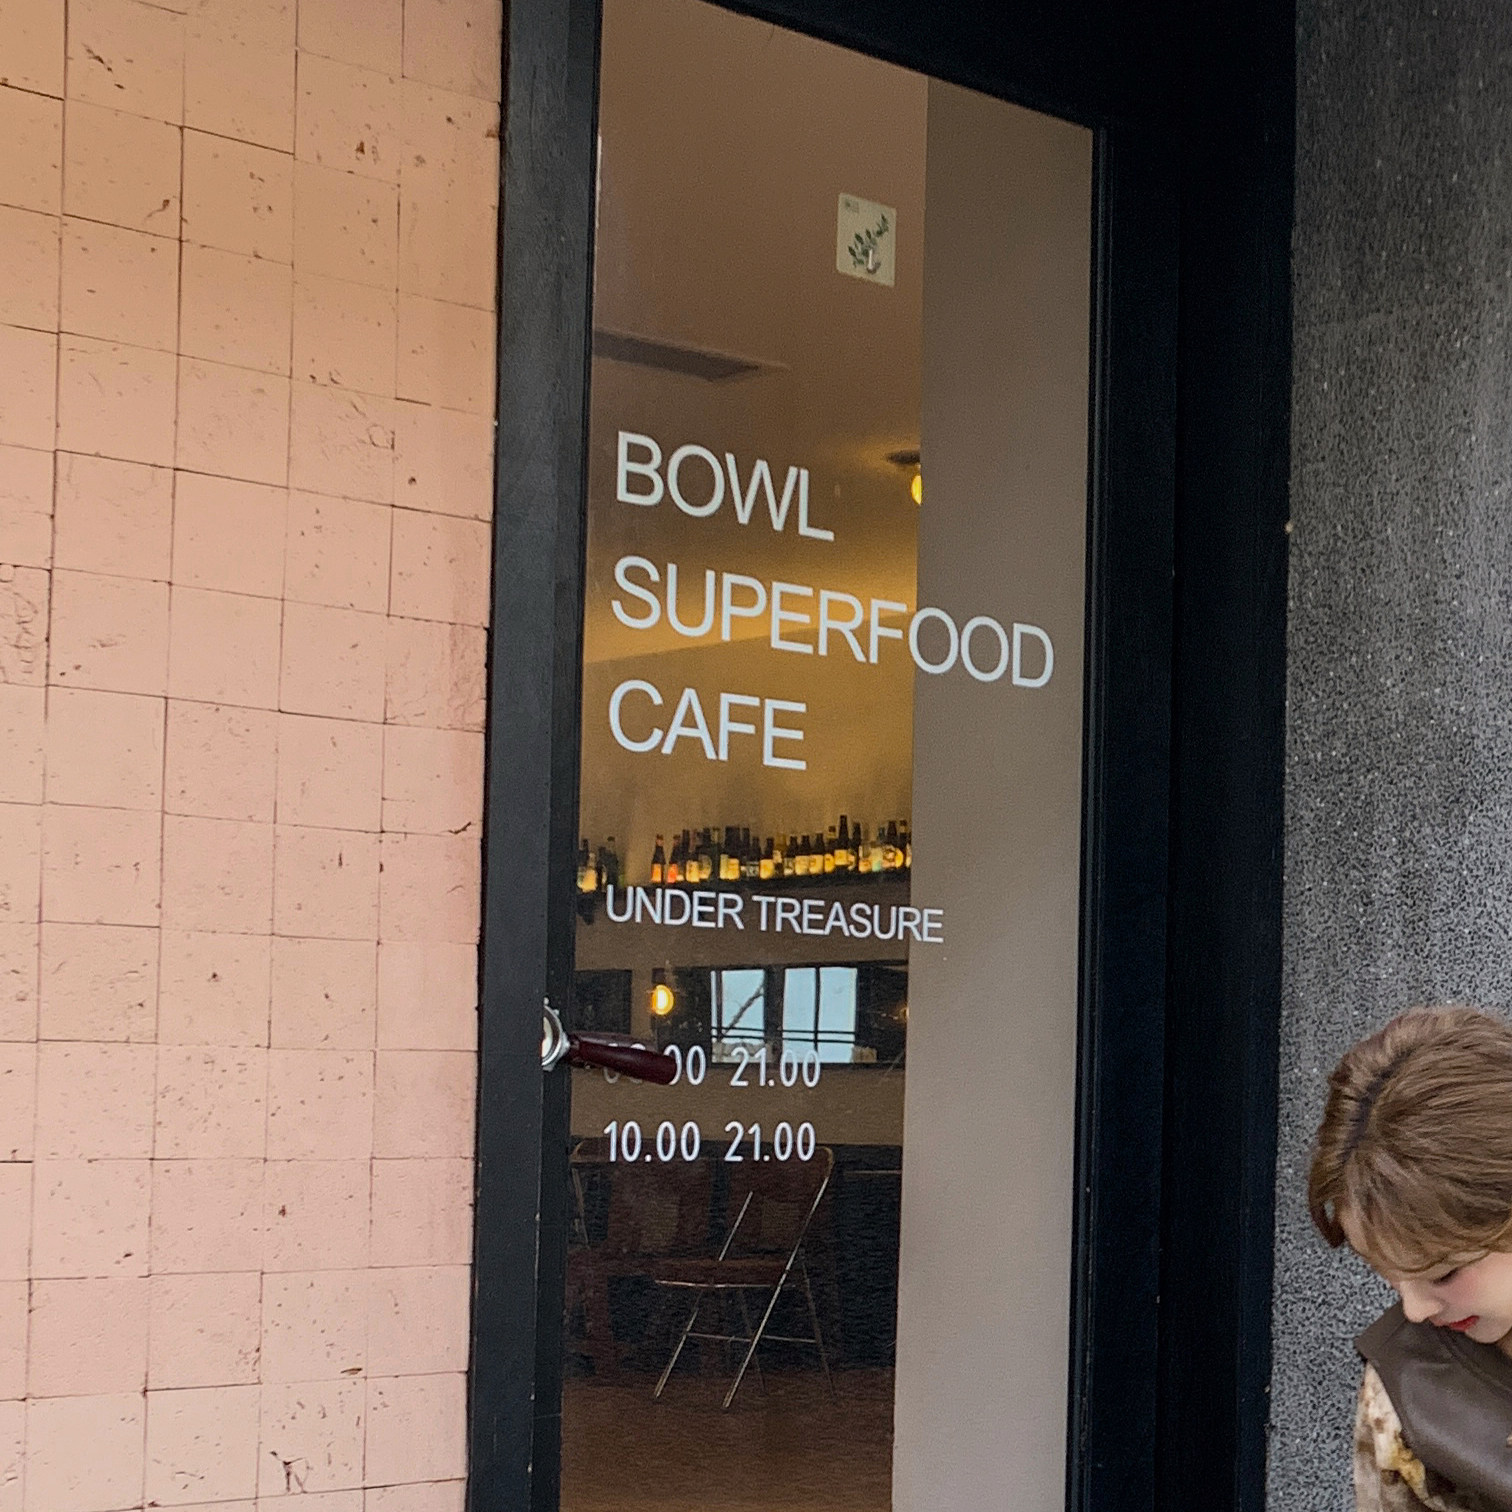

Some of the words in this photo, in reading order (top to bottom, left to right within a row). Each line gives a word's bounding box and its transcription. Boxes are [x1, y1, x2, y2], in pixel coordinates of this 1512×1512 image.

[616, 431, 834, 542] BOWL
[611, 556, 1054, 688] SUPERFOOD
[608, 680, 807, 770] CAFE
[606, 884, 744, 930] UNDER
[752, 894, 943, 943] TREASURE
[729, 1046, 821, 1088] 21.00
[603, 1120, 700, 1162] 10.00
[724, 1121, 816, 1162] 21.00
